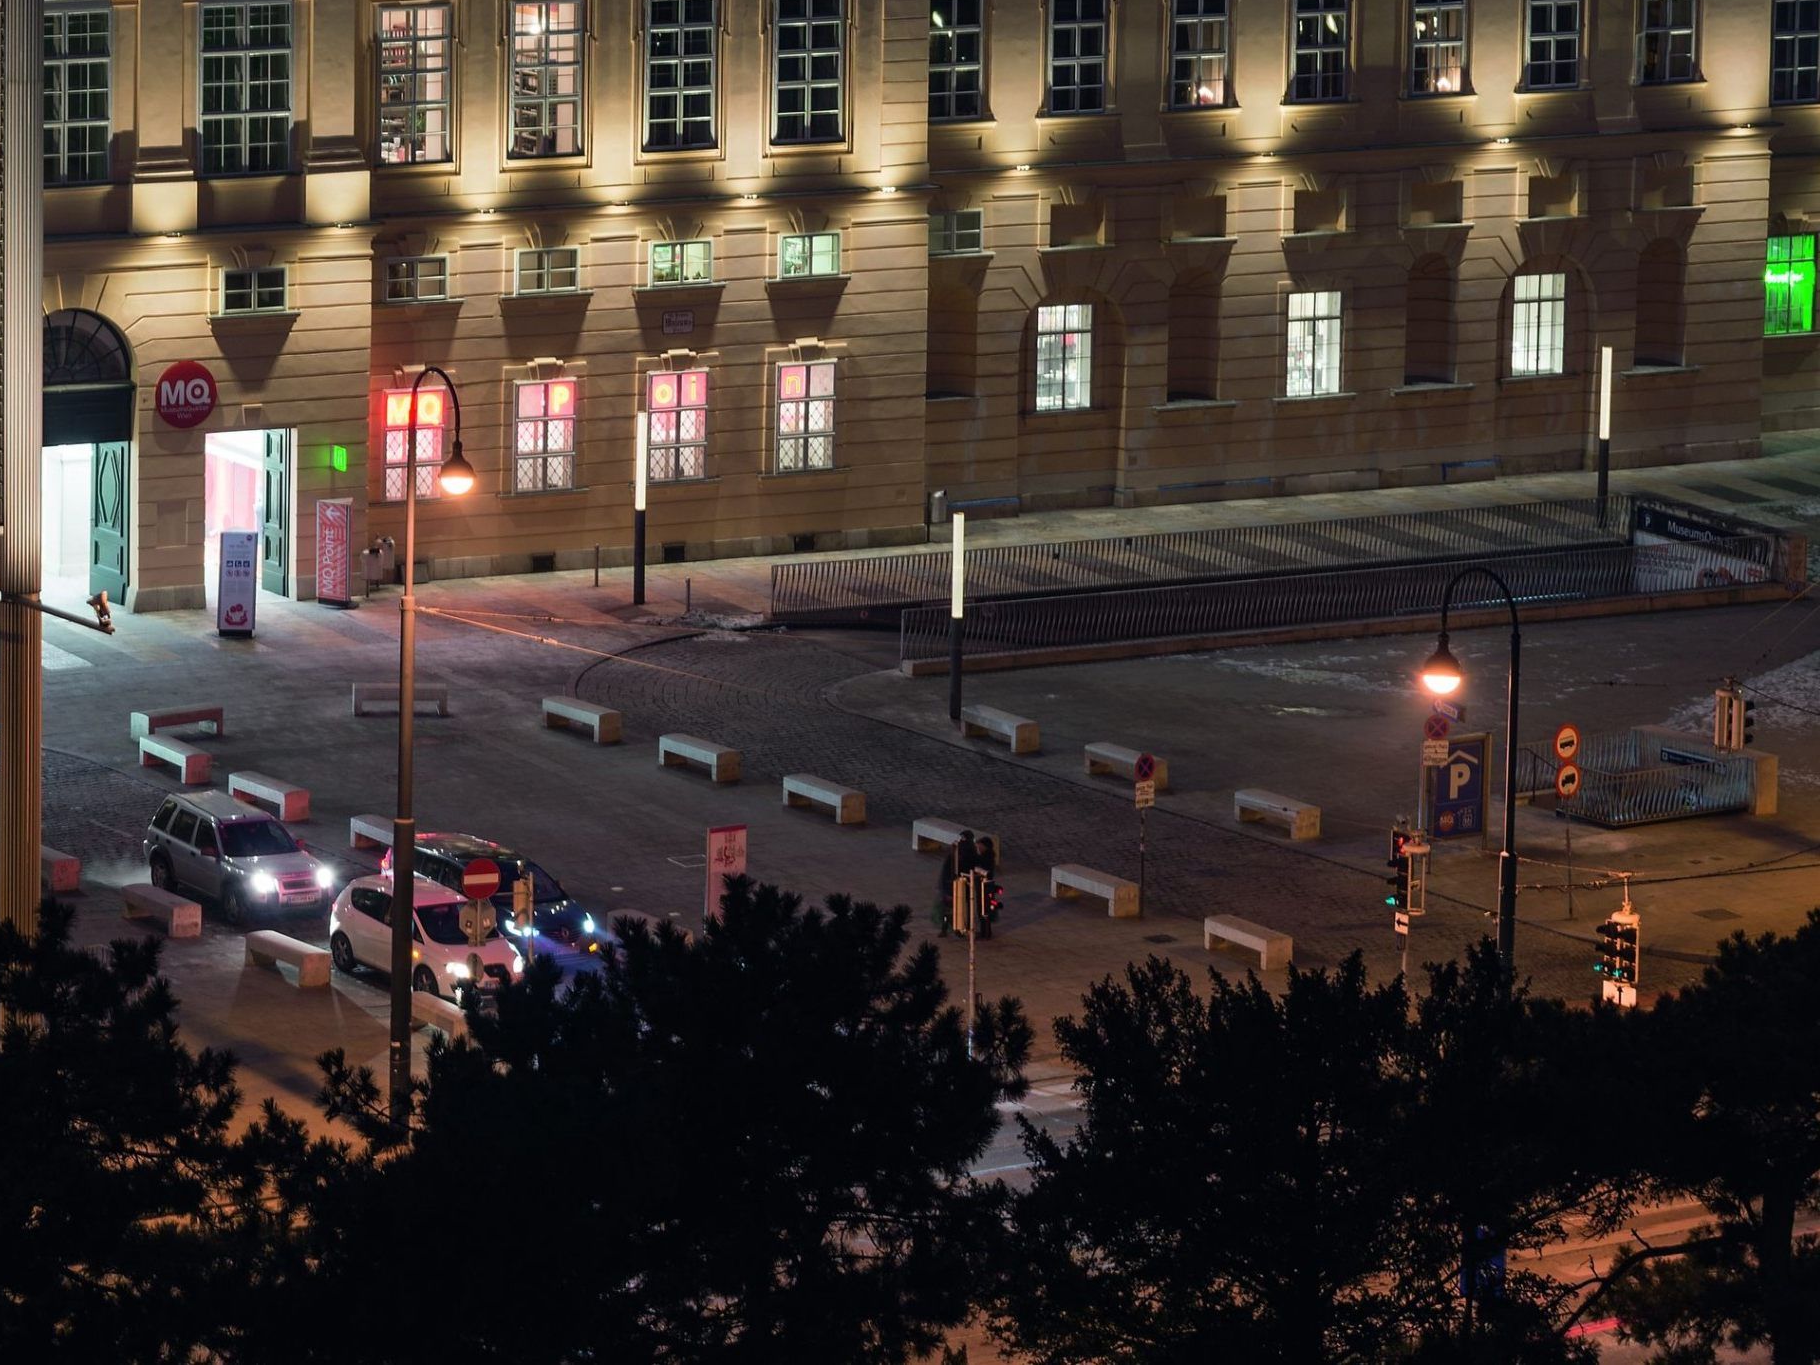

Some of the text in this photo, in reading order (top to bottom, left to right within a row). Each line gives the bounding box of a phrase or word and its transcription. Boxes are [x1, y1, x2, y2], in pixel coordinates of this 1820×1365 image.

[161, 377, 211, 407] MQ
[386, 394, 441, 426] MQ
[322, 527, 336, 594] MQ Point
[1449, 762, 1471, 800] P
